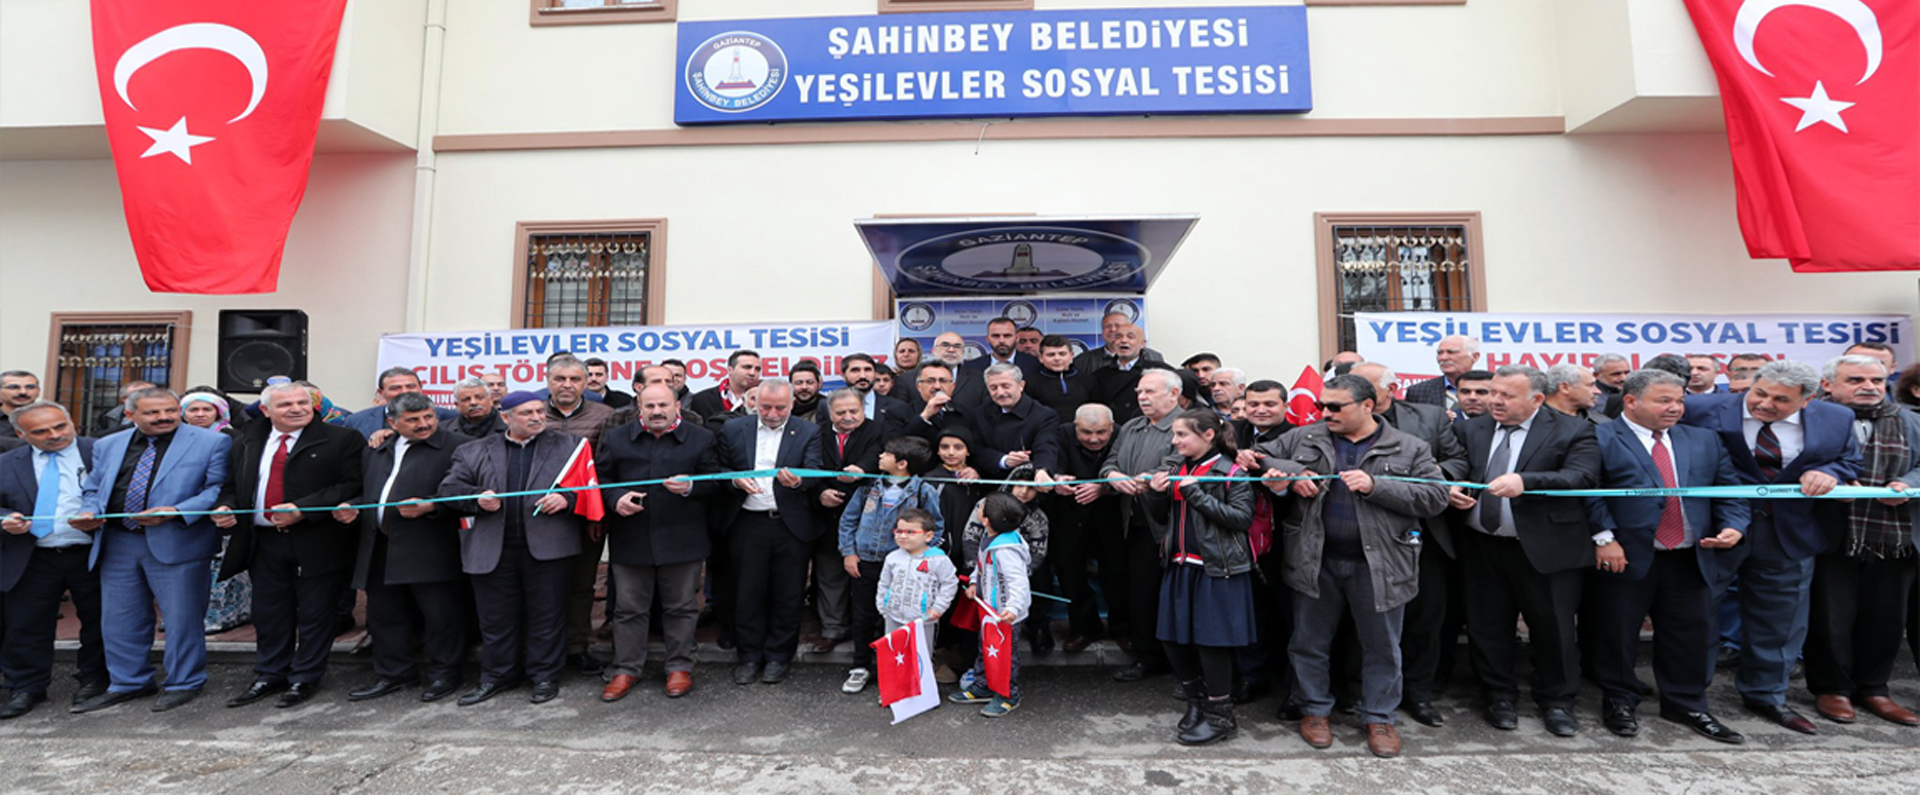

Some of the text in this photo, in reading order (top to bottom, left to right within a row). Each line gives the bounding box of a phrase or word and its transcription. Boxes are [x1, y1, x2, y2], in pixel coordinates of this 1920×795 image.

[1022, 67, 1160, 99] SOSYAL
[425, 332, 610, 360] YEŞİLEVLER
[618, 330, 741, 352] SOSYAL
[1615, 321, 1768, 345] SOSYAL
